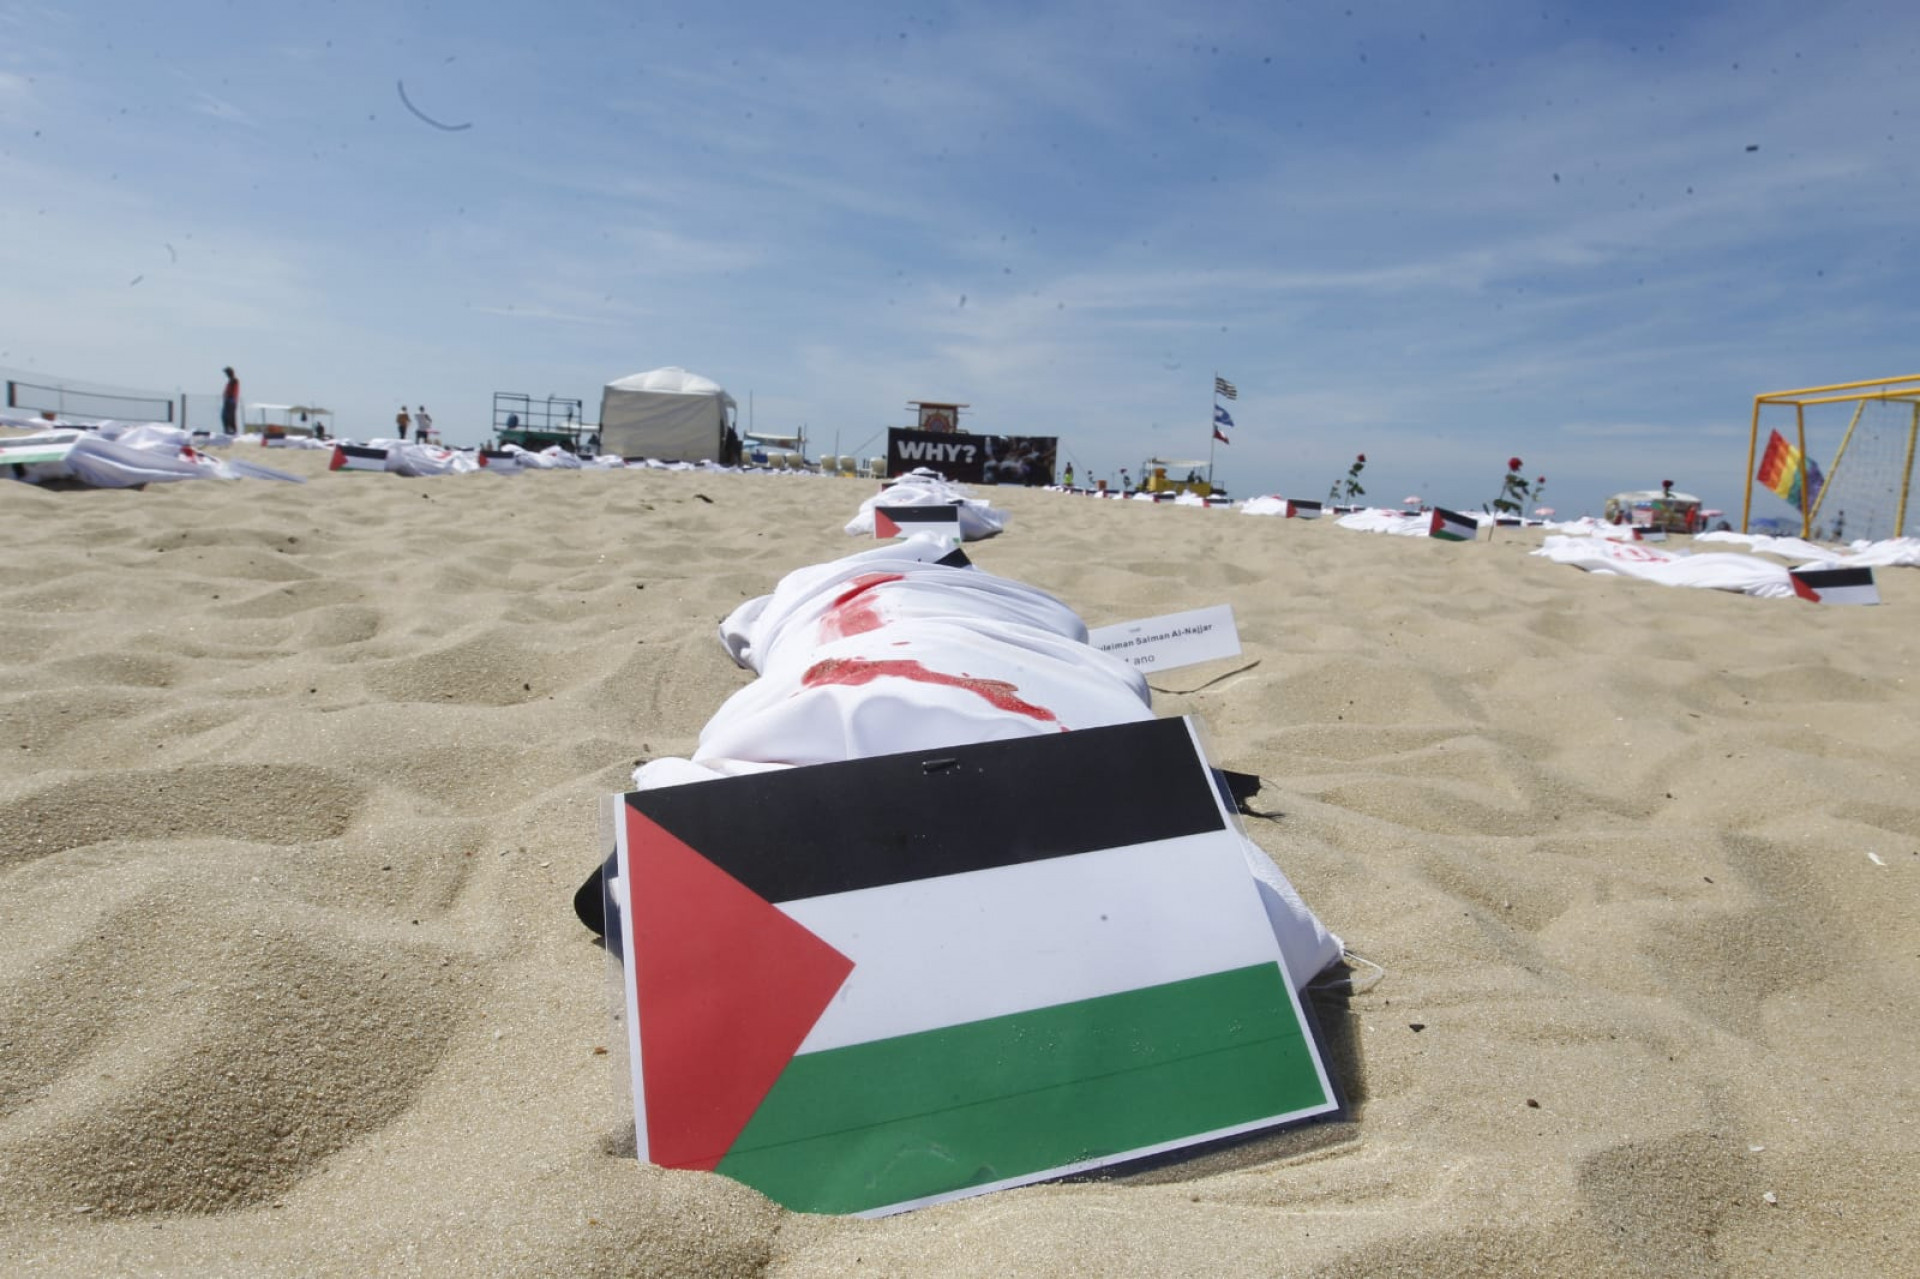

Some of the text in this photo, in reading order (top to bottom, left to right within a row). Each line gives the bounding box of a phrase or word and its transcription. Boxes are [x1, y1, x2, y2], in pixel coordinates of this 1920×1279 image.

[897, 440, 977, 463] WHY?
[1135, 632, 1170, 644] Salman
[1171, 624, 1213, 638] Al-Najjar
[1133, 654, 1155, 665] ano
